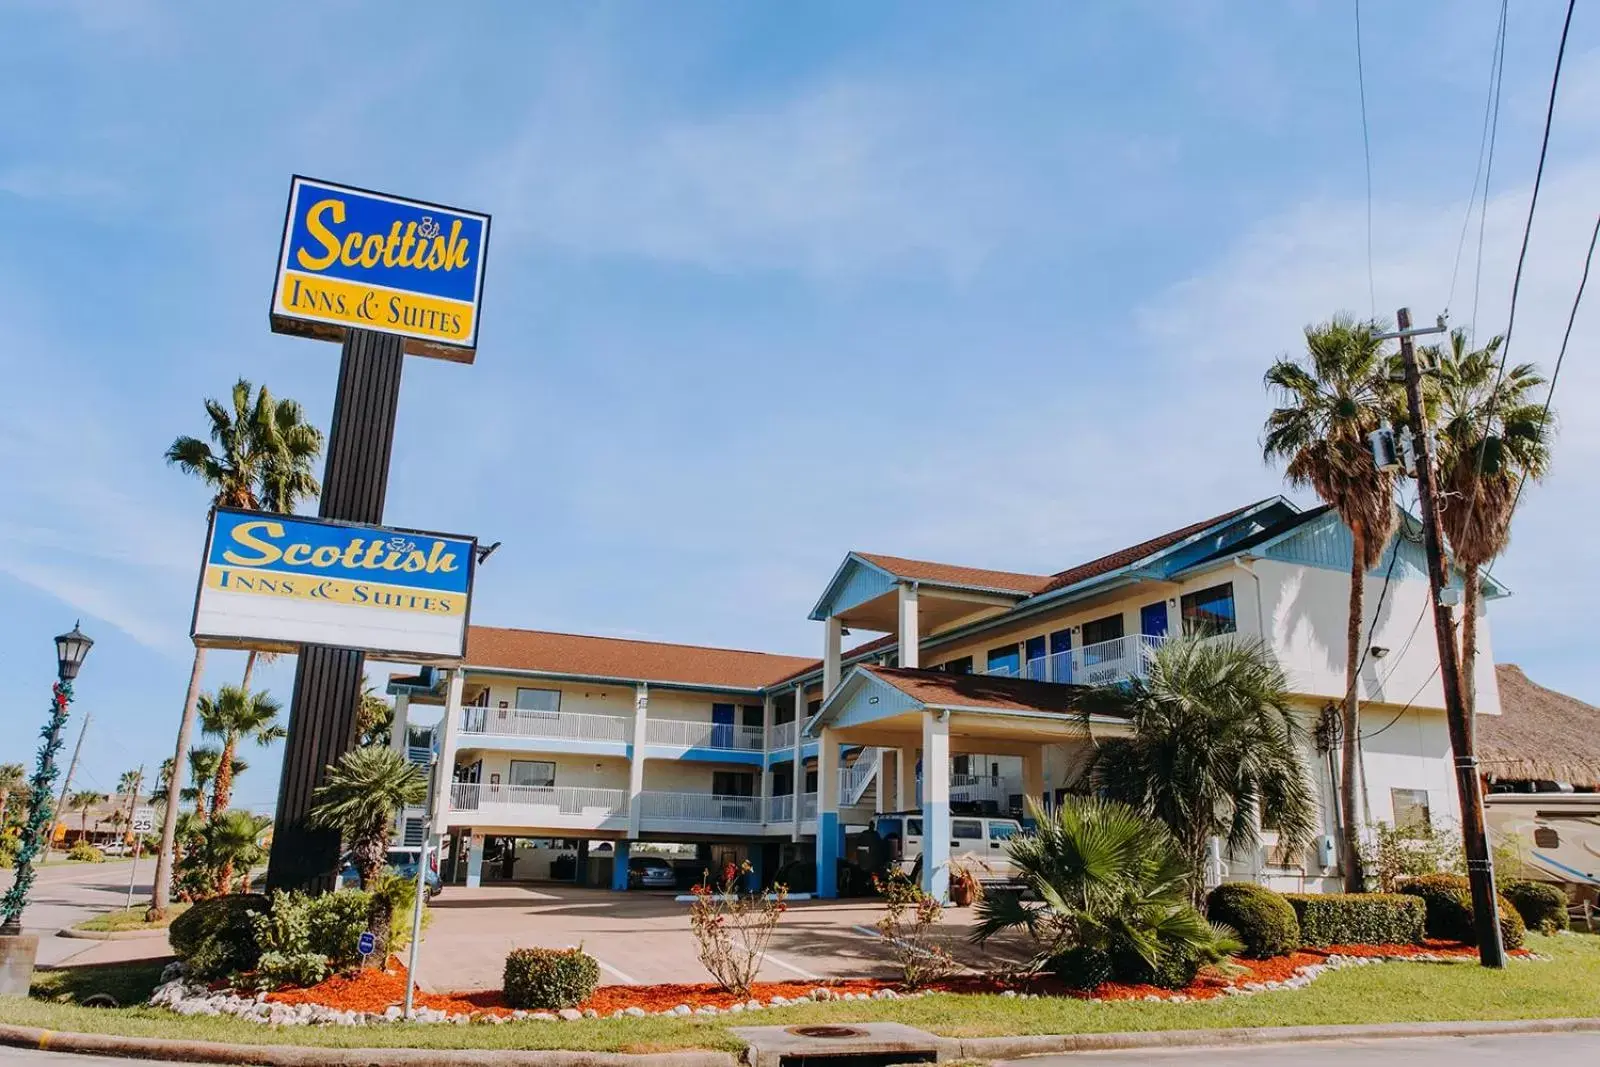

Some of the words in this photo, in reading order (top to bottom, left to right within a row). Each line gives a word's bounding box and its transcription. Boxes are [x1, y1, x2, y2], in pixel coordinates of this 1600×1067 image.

[297, 199, 470, 271] Scottish
[290, 279, 346, 315] INNS
[356, 291, 379, 320] &
[387, 296, 462, 334] SUITES
[222, 521, 459, 573] Scottish
[220, 570, 294, 594] INNS
[310, 581, 339, 599] &
[352, 585, 451, 612] SUITES
[133, 820, 151, 830] 25
